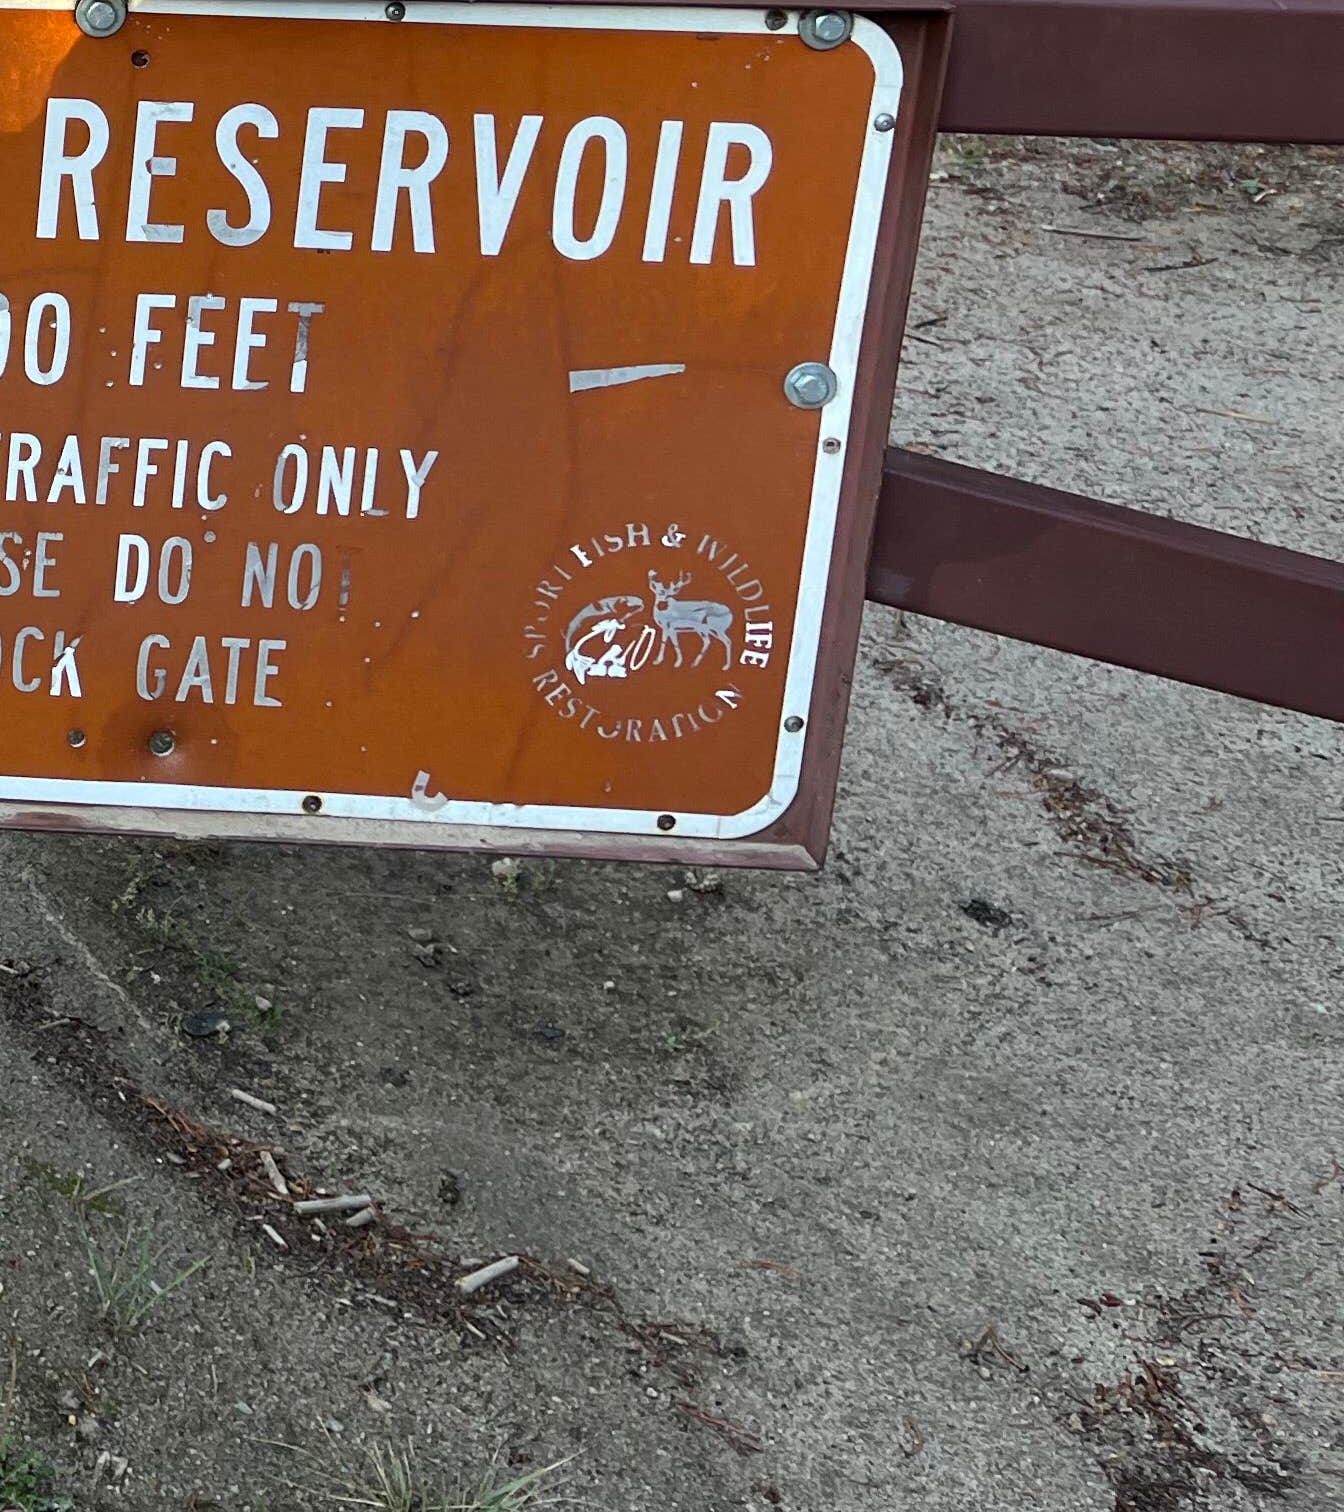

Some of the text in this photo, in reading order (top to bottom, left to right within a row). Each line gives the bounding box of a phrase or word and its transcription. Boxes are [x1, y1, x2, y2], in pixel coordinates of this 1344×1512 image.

[36, 98, 773, 266] RESERVOIR
[129, 293, 325, 392] FEET
[273, 444, 439, 519] ONLY
[114, 534, 192, 604] DO
[661, 523, 687, 548] &
[136, 634, 288, 707] GATE
